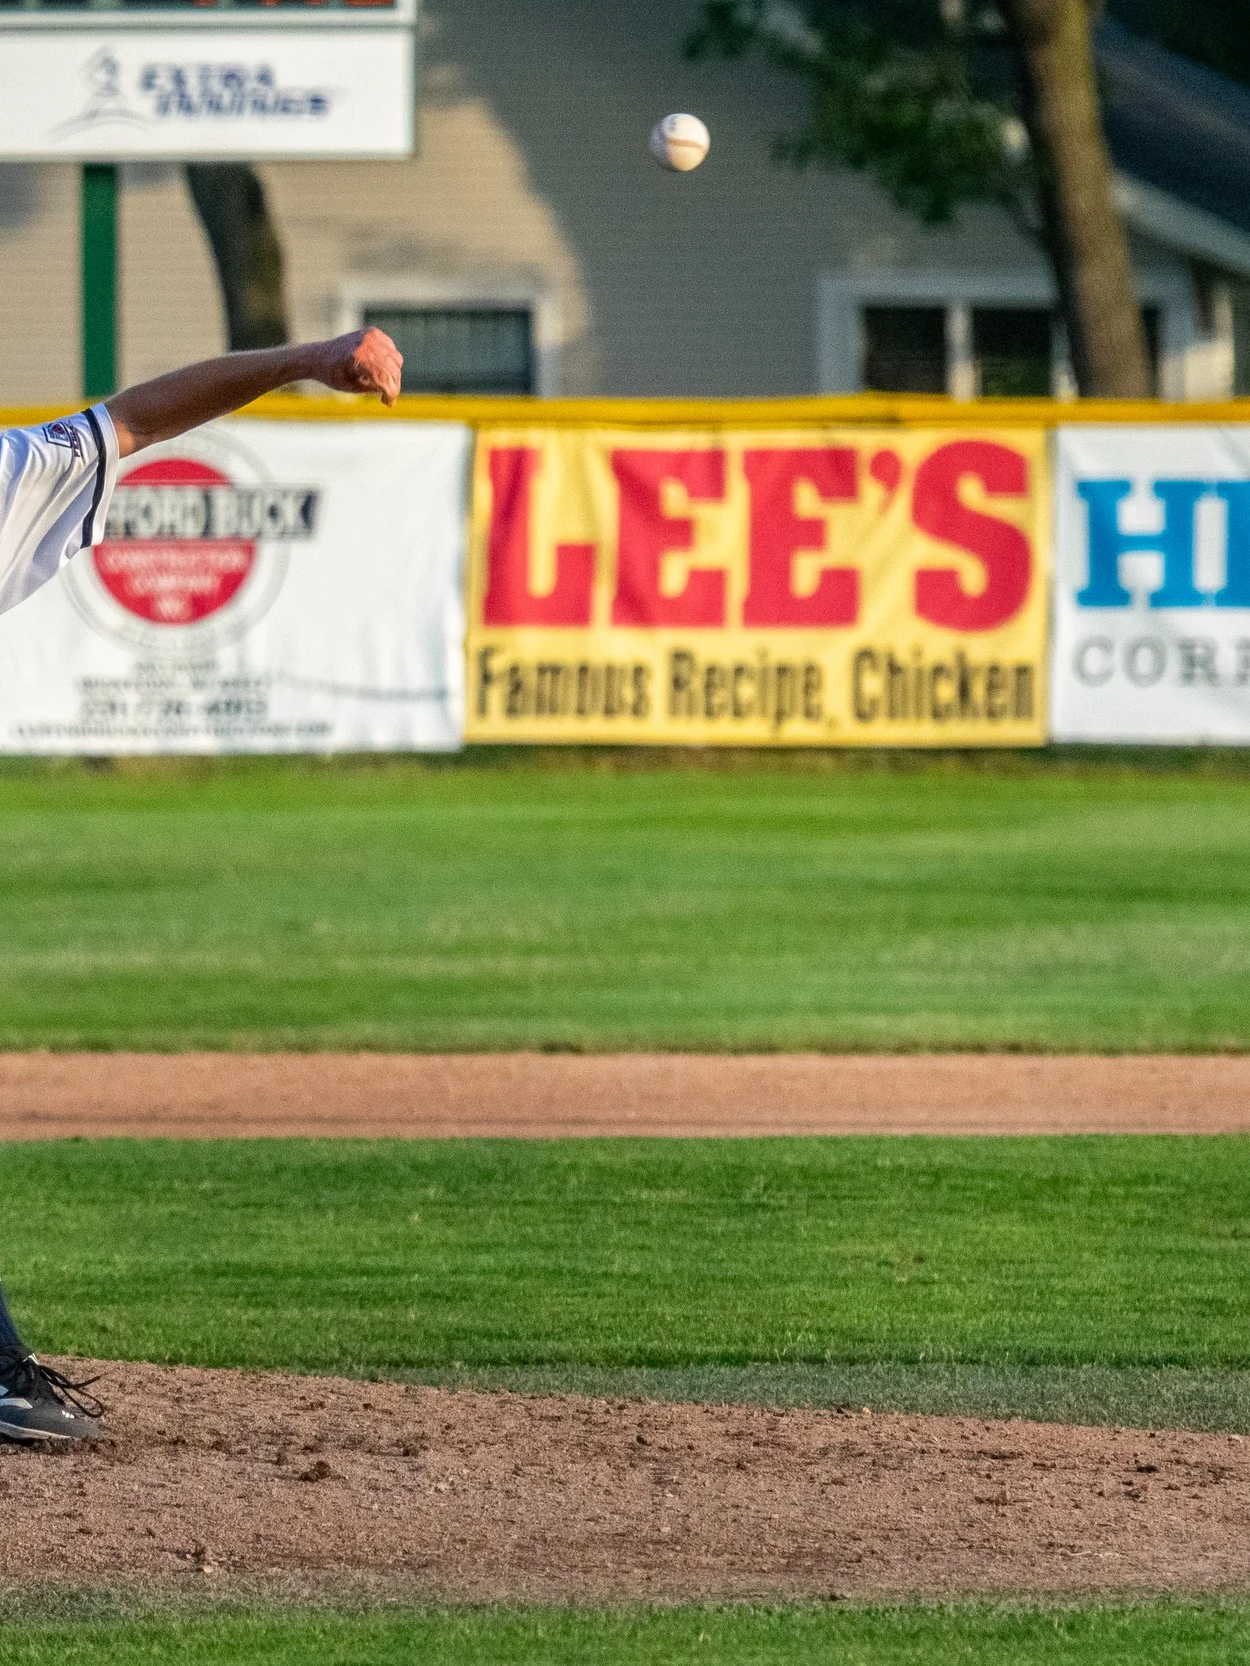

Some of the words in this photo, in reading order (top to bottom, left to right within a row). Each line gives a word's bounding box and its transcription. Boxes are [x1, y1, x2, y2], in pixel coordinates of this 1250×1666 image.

[483, 440, 1032, 632] LEE'S
[477, 646, 652, 720] Famous
[850, 645, 1038, 724] Chicken
